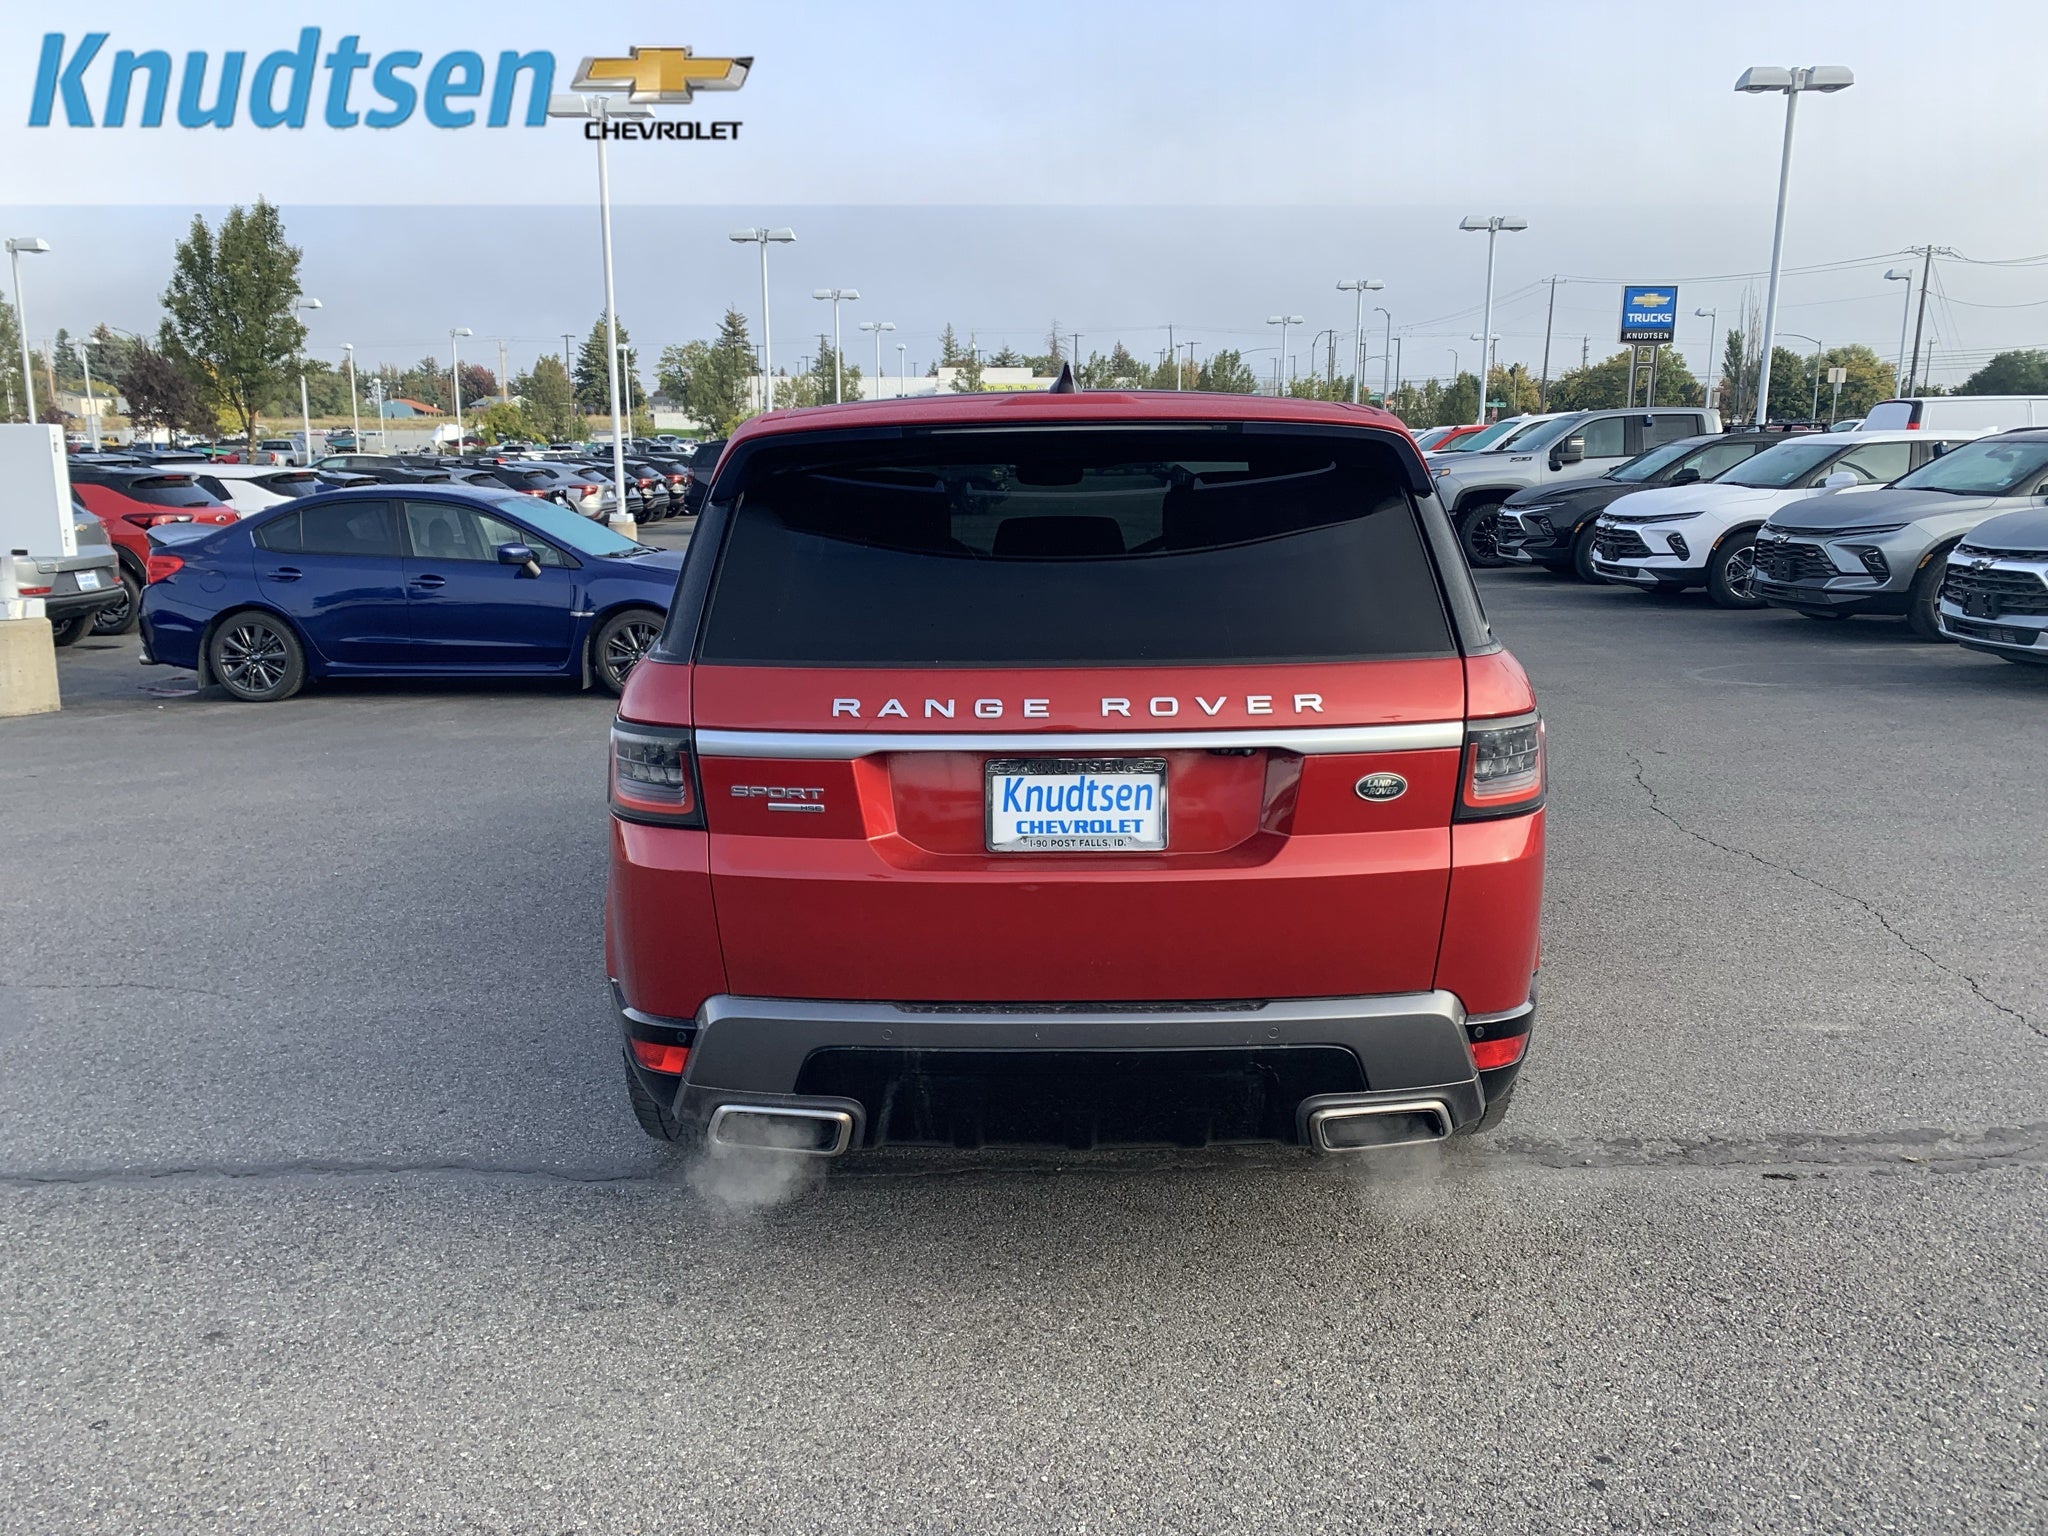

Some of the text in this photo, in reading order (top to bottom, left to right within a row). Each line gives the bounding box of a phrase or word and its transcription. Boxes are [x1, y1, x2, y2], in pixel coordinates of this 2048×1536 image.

[1627, 313, 1672, 323] TRUCKS
[1626, 332, 1669, 340] KNUDTSEN
[831, 693, 1325, 719] RANGE ROVER
[1029, 761, 1124, 774] KNUDTSEN
[1366, 779, 1392, 787] LAND
[730, 785, 825, 800] SPORT
[1002, 775, 1153, 813] Knudtsen
[1368, 787, 1398, 795] ROVER
[1016, 819, 1144, 835] CHEVROLET
[1029, 838, 1127, 848] I-90 POST FALLS, ID.
